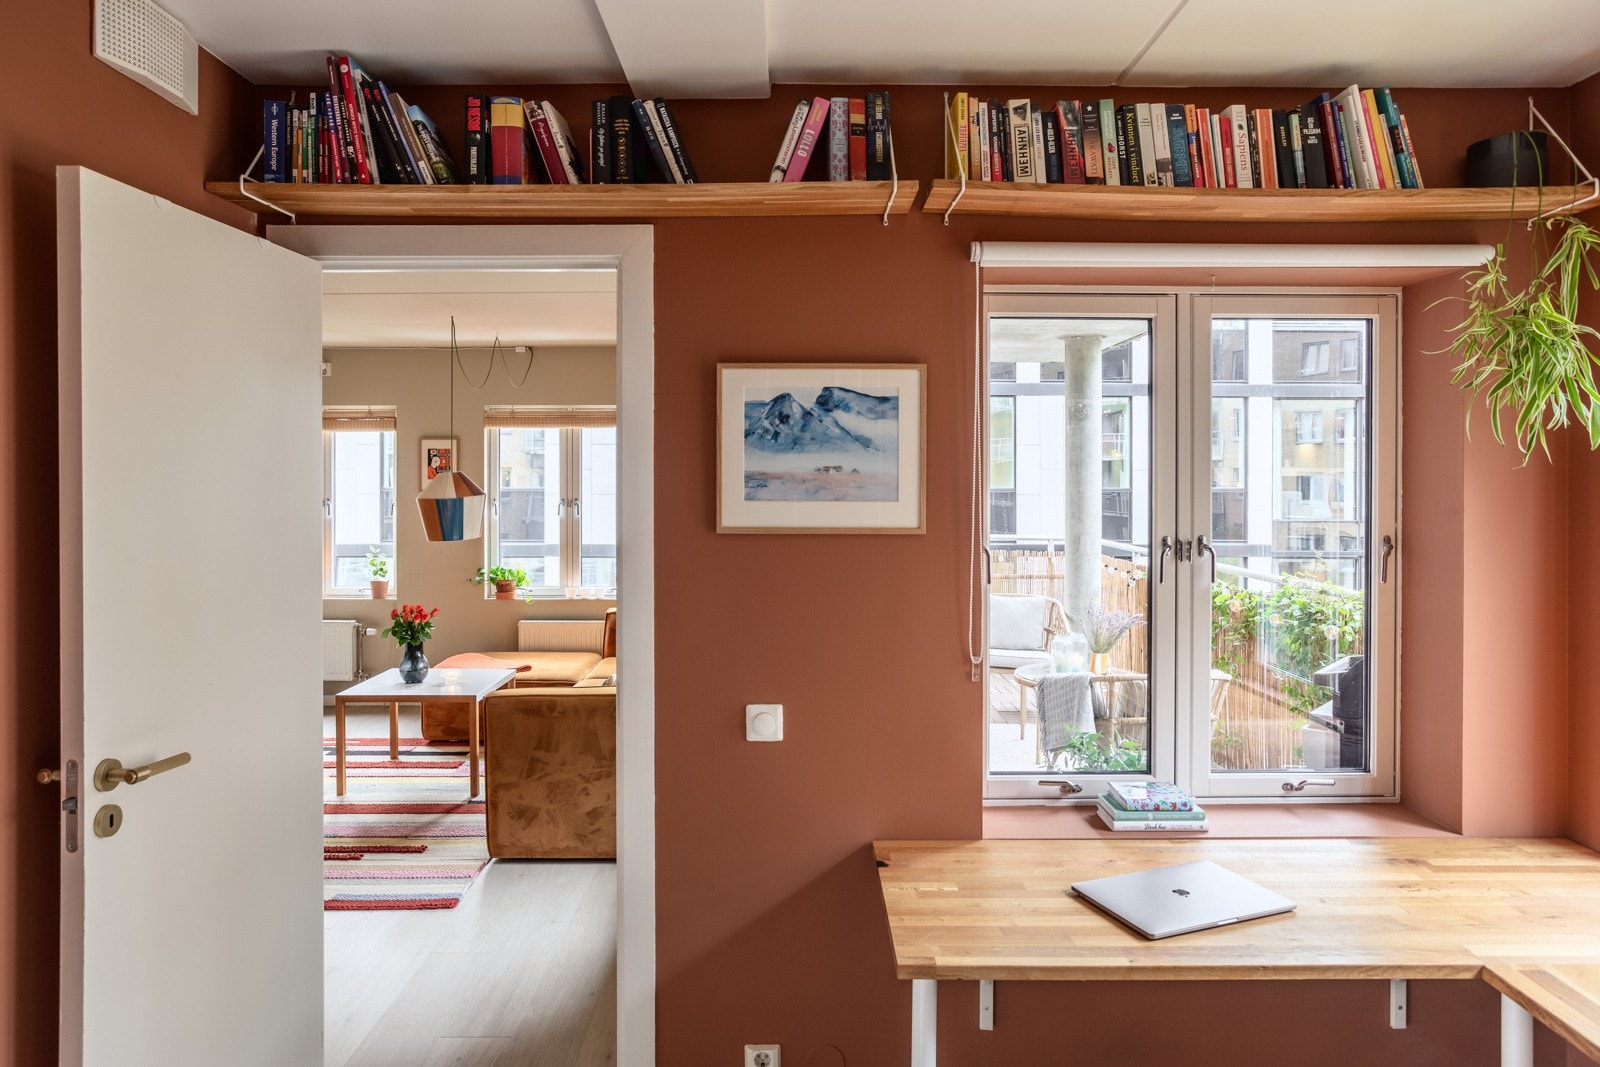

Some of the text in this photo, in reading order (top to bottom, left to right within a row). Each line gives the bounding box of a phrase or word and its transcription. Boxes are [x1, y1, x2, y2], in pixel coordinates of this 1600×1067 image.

[467, 97, 480, 131] JO NESBØ
[659, 107, 671, 127] NATASCHA
[668, 127, 679, 149] KAMPUSCH
[1126, 113, 1136, 145] Kvinnen
[353, 135, 363, 163] SYKKELTURER
[797, 129, 815, 158] LOLLO
[1047, 129, 1055, 153] ADLER-OLSEN
[1236, 132, 1248, 171] Sapiens
[1394, 129, 1403, 149] KINA
[1130, 153, 1139, 182] vinduet
[1172, 128, 1189, 182] SVERMEN
